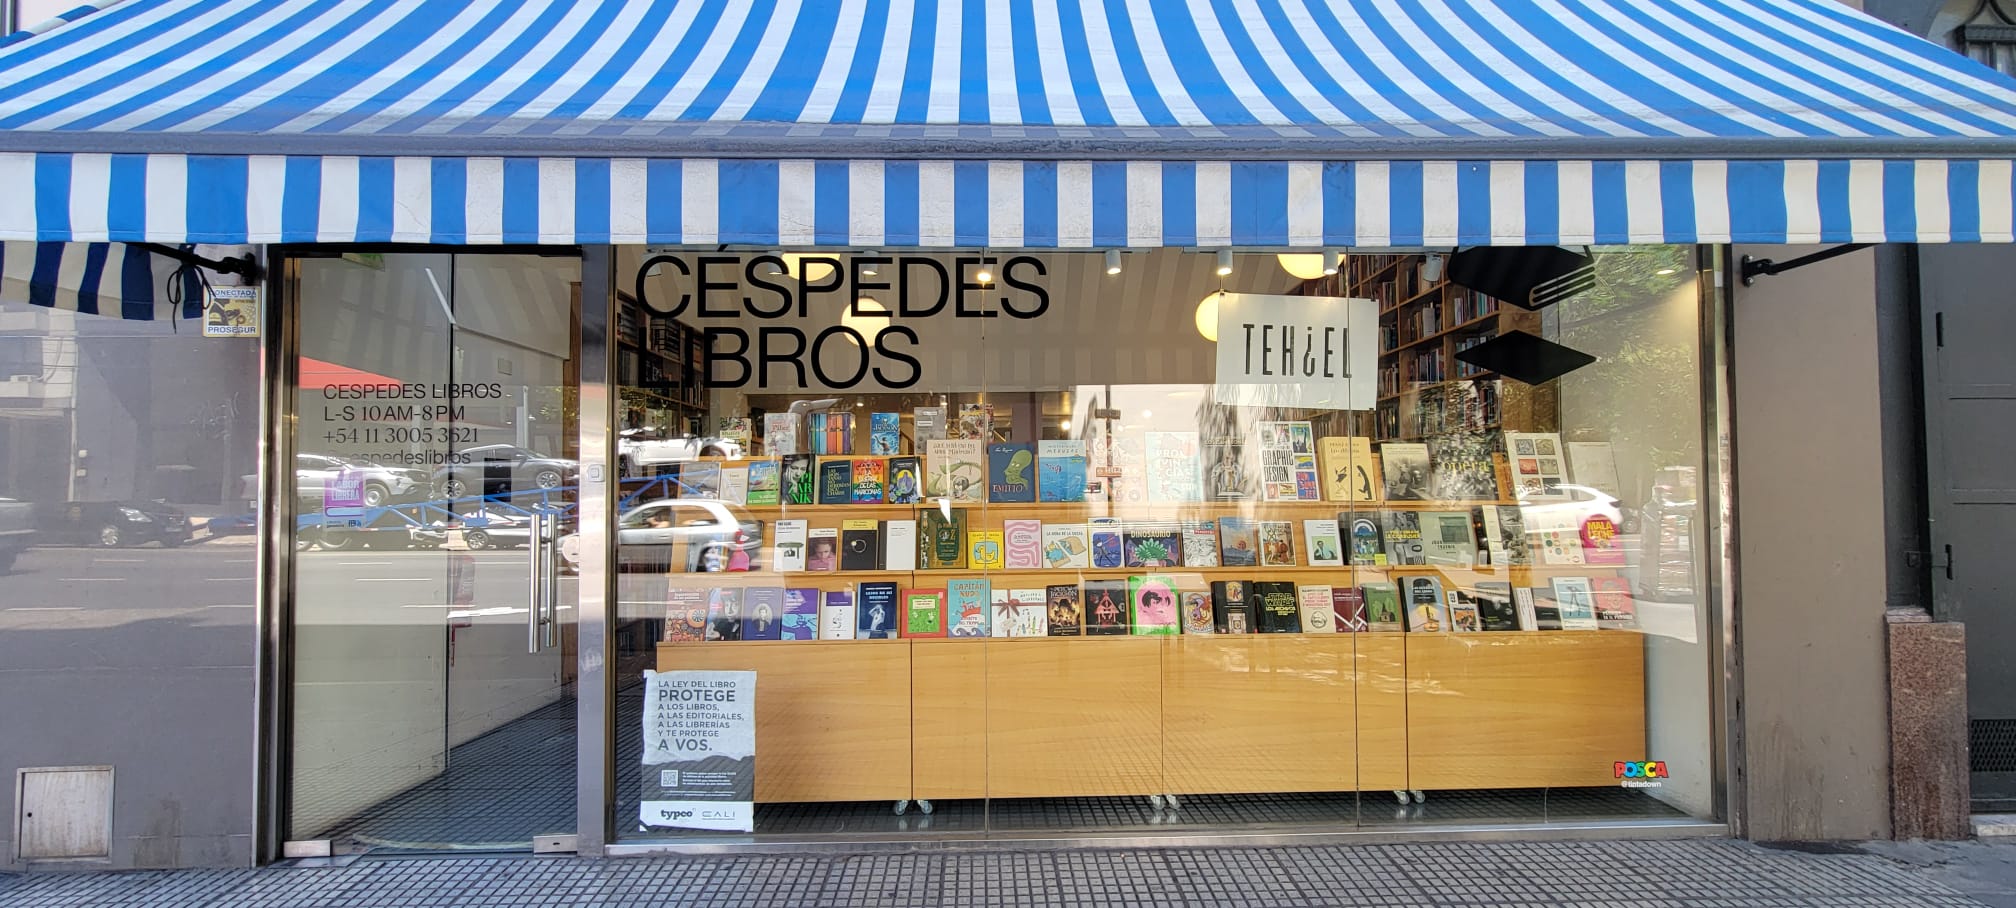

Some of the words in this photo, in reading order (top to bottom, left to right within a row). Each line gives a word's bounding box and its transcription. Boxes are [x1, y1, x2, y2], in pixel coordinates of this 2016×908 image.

[208, 326, 256, 334] PROSEGUR
[638, 325, 922, 389] LIBROS
[323, 384, 426, 400] CESPEDES
[433, 383, 502, 399] LIBROS
[324, 406, 355, 421] L-S
[323, 428, 359, 443] +54
[365, 428, 379, 443] 11
[384, 427, 433, 443] 3005
[1262, 449, 1294, 466] GRAPHIC
[1265, 466, 1290, 482] DESIGN
[1587, 521, 1614, 531] MALA
[659, 689, 736, 702] PROTEGE
[686, 704, 720, 712] LIBROS,
[686, 712, 744, 721] EDITORIALES,
[686, 720, 730, 729] LIBRERÍAS
[658, 739, 669, 751] A
[675, 738, 713, 751] VOS.
[1613, 761, 1669, 778] POSCA
[661, 809, 693, 820] typco
